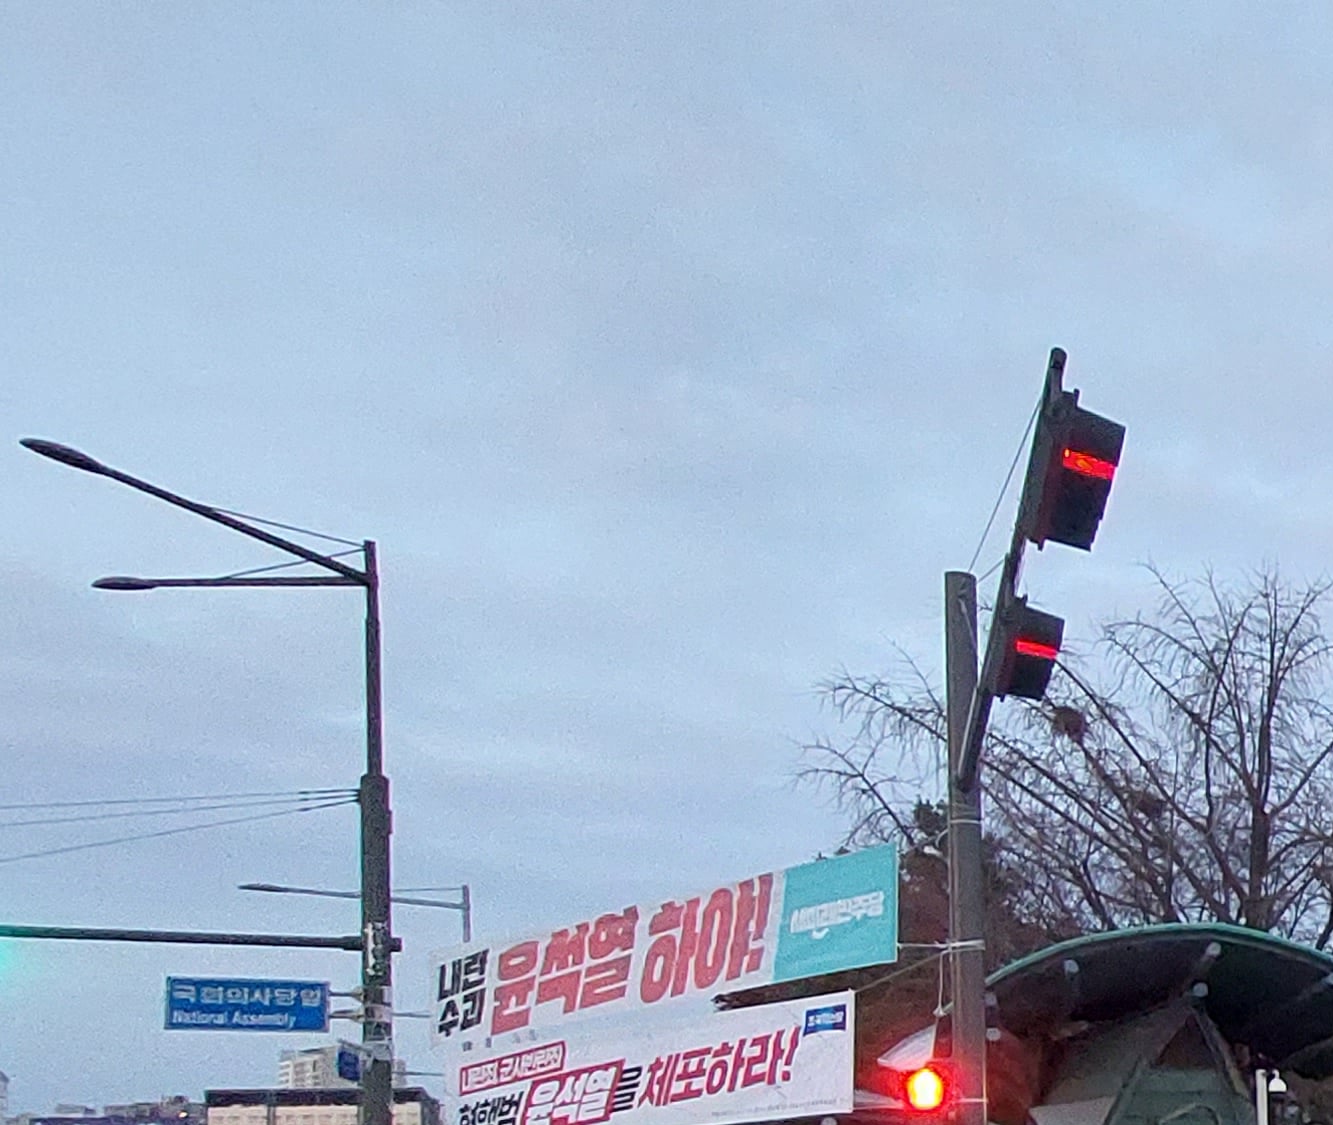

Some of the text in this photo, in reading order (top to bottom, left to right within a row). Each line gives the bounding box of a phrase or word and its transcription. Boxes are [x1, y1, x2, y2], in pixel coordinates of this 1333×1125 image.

[437, 948, 489, 1001] 내란
[490, 873, 774, 1035] 윤석열 하야!
[172, 1010, 297, 1029] National Assembly
[437, 992, 487, 1038] 수괴
[638, 1025, 802, 1109] 체포하라!
